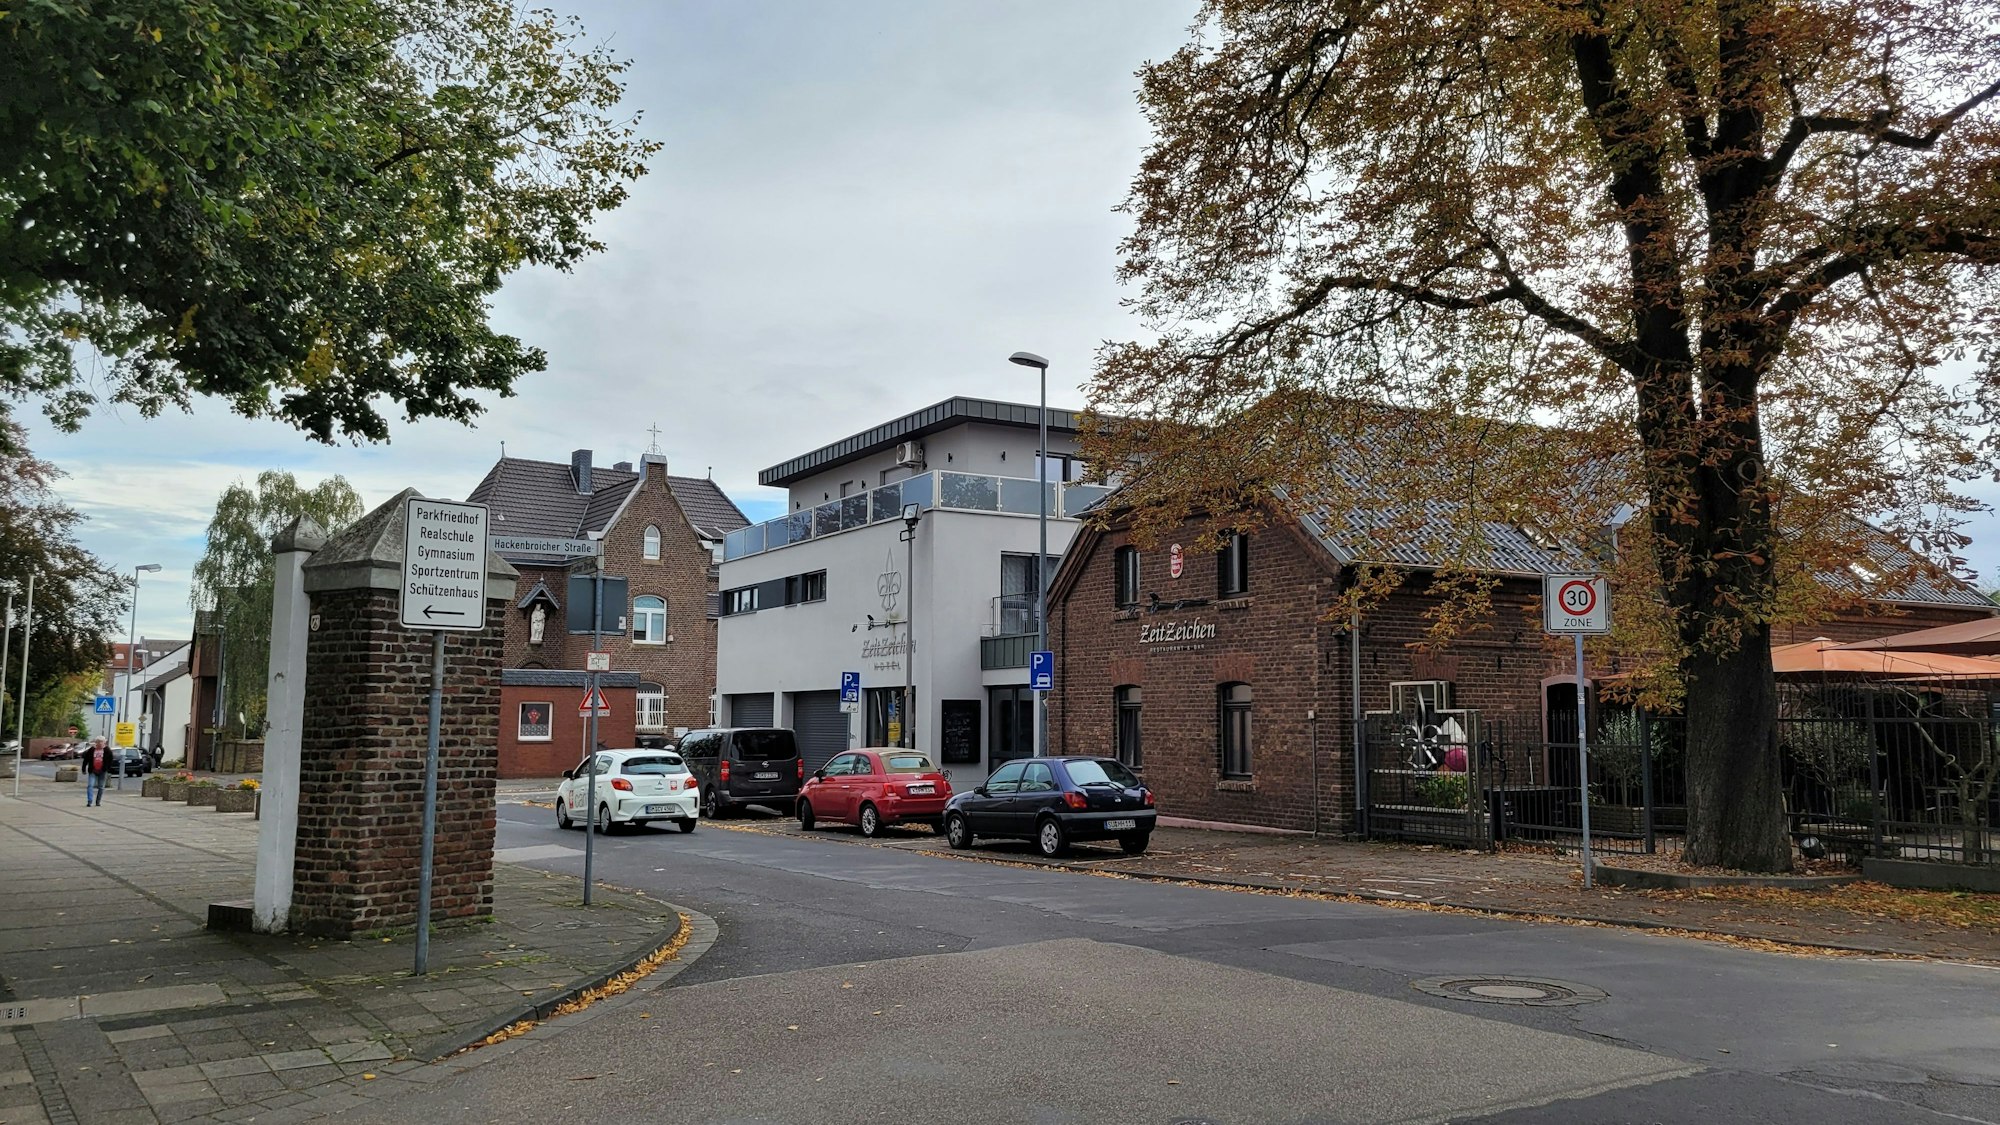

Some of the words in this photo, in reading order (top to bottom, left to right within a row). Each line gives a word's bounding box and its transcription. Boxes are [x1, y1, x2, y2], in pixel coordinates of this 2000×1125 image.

[417, 507, 479, 525] Parkfriedhof
[420, 526, 474, 543] Realschule
[418, 545, 475, 561] Gymnasium
[494, 539, 560, 552] Hackenbroicher
[564, 542, 592, 553] Straße
[411, 563, 479, 580] Sportzentrum
[409, 582, 479, 599] Schützenhaus
[1566, 590, 1588, 606] 30
[1139, 617, 1216, 643] ZeitZeichen
[1564, 618, 1593, 627] ZONE
[861, 633, 916, 658] ZeitZeichn
[874, 661, 901, 671] HOTEL
[1033, 654, 1044, 670] P
[844, 673, 853, 686] P
